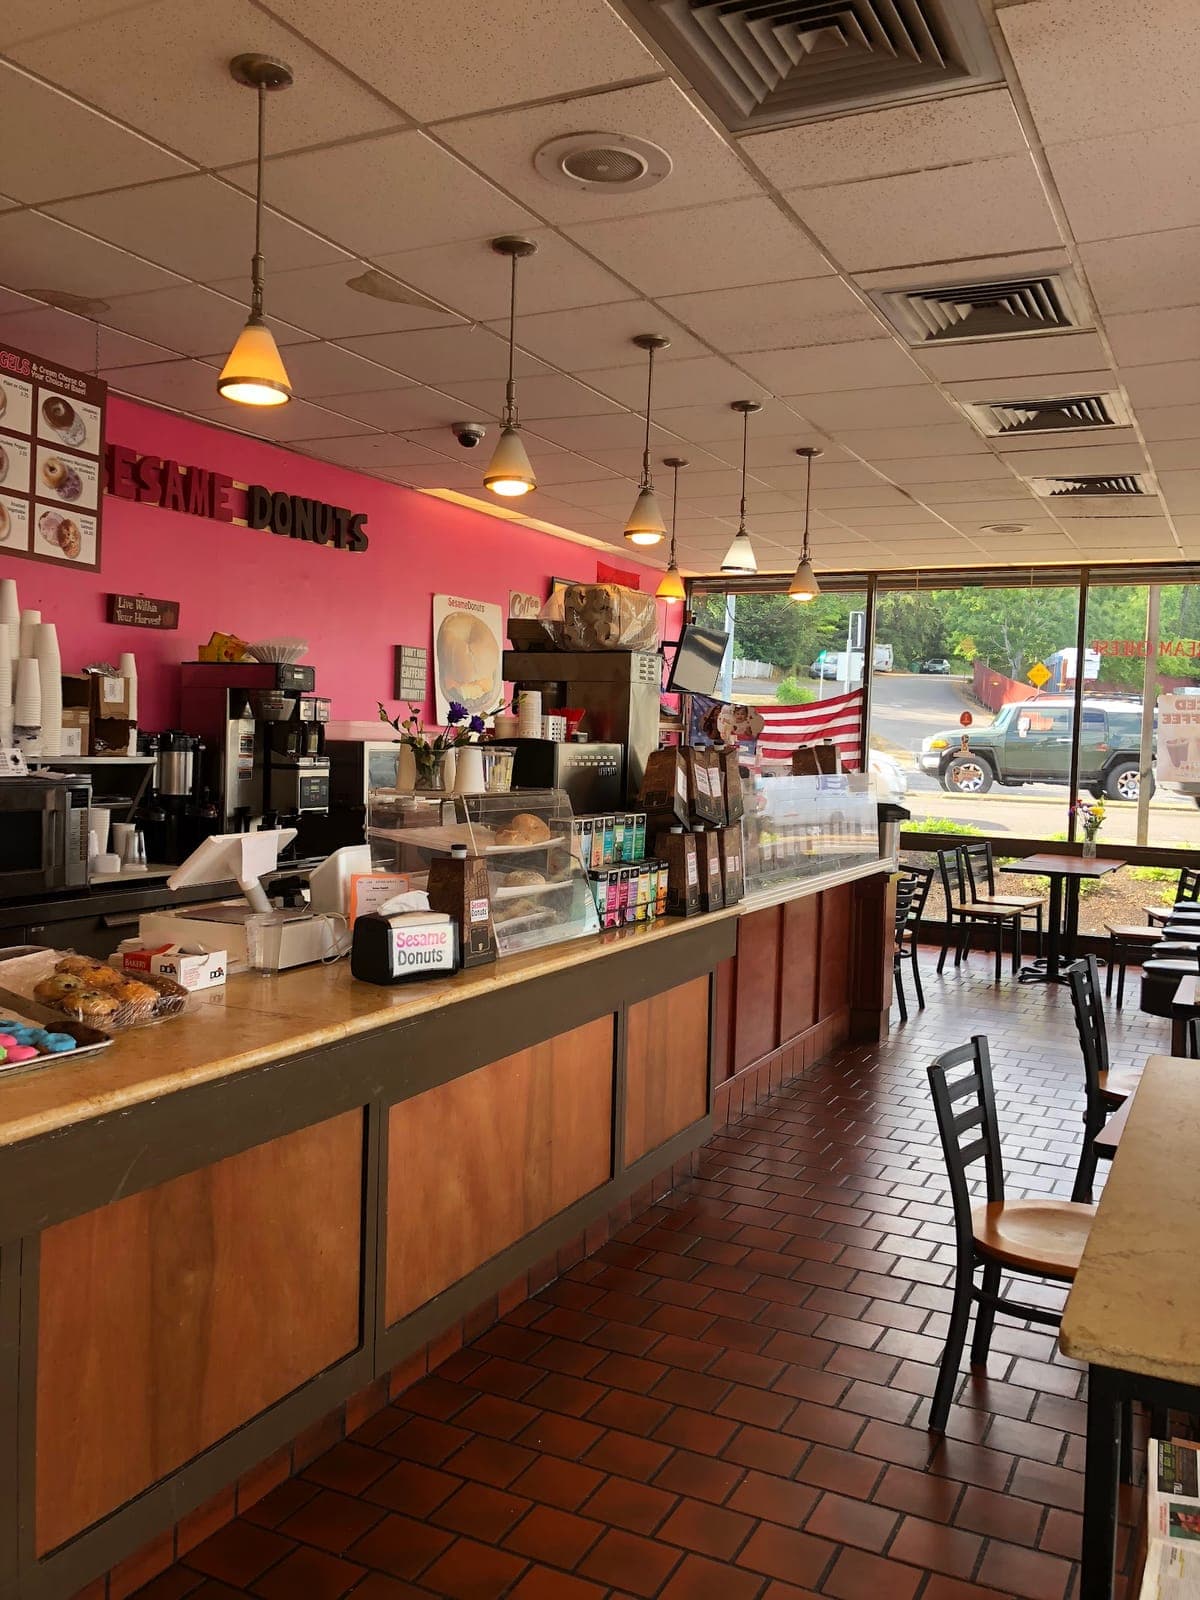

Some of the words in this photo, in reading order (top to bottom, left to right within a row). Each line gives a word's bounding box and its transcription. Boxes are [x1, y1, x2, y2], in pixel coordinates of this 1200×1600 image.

[31, 370, 44, 380] Your
[45, 376, 64, 388] Choice
[39, 366, 57, 377] Cream
[58, 373, 77, 384] Cheese
[78, 380, 87, 388] On
[249, 485, 368, 553] DONUTS
[118, 596, 134, 609] Live
[135, 599, 158, 612] Within
[511, 594, 539, 617] Coffee
[116, 609, 133, 622] Your
[134, 612, 161, 625] Harvest
[471, 901, 488, 910] Sesame
[471, 908, 487, 917] Donuts
[397, 930, 447, 948] Sesame
[125, 959, 146, 969] BAKERY
[398, 949, 443, 966] Donuts
